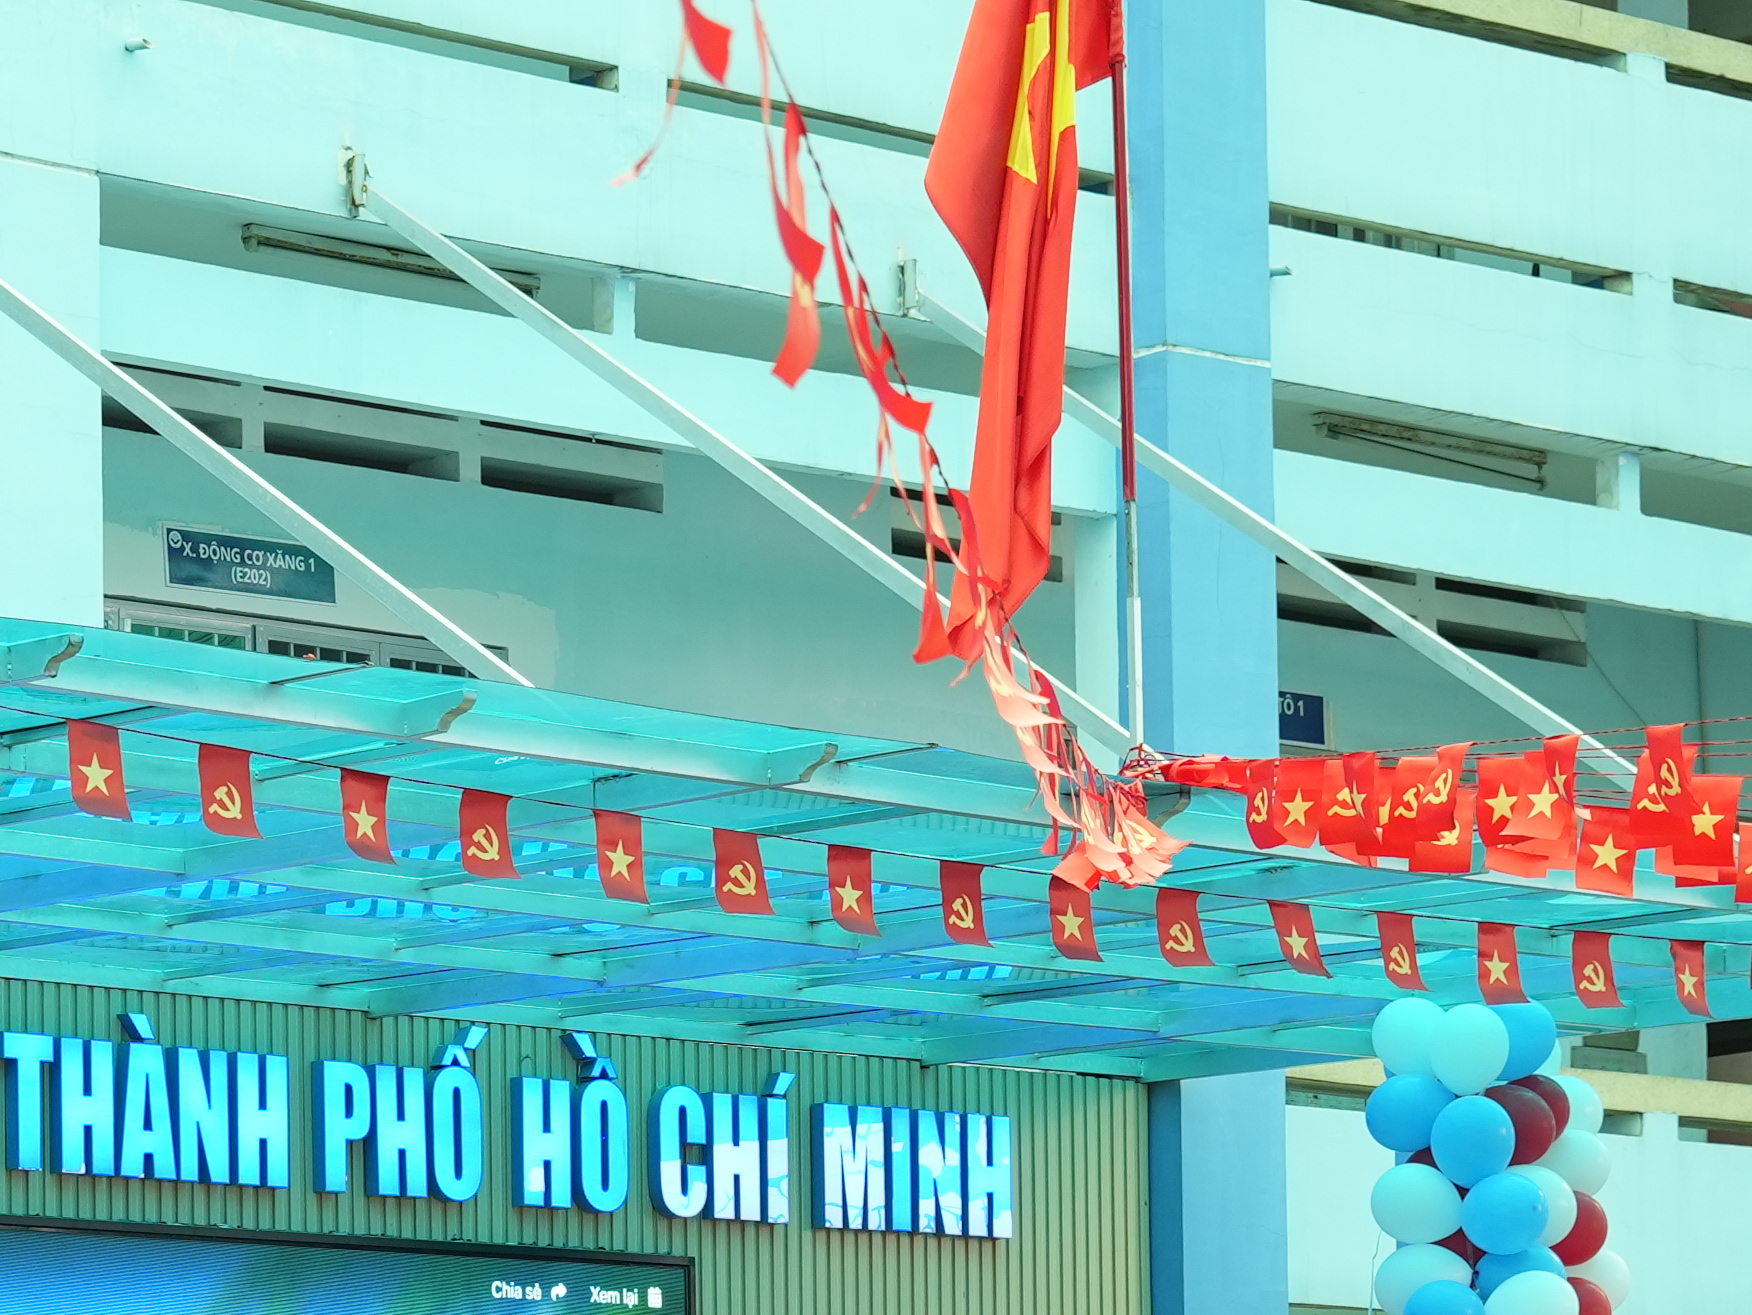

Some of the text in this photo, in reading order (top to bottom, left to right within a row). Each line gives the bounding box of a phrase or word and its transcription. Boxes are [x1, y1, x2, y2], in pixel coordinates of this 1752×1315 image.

[182, 541, 316, 573] X. ĐỘNG CƠ XĂNG 1
[231, 566, 271, 589] (E202)
[1297, 700, 1304, 717] 1
[311, 1023, 491, 1204] PHỐ
[509, 1031, 630, 1216] HỒ
[648, 1070, 797, 1224] CHÍ
[810, 1100, 1012, 1242] MINH
[491, 1280, 523, 1300] Chia
[589, 1286, 639, 1309] Xem lại
